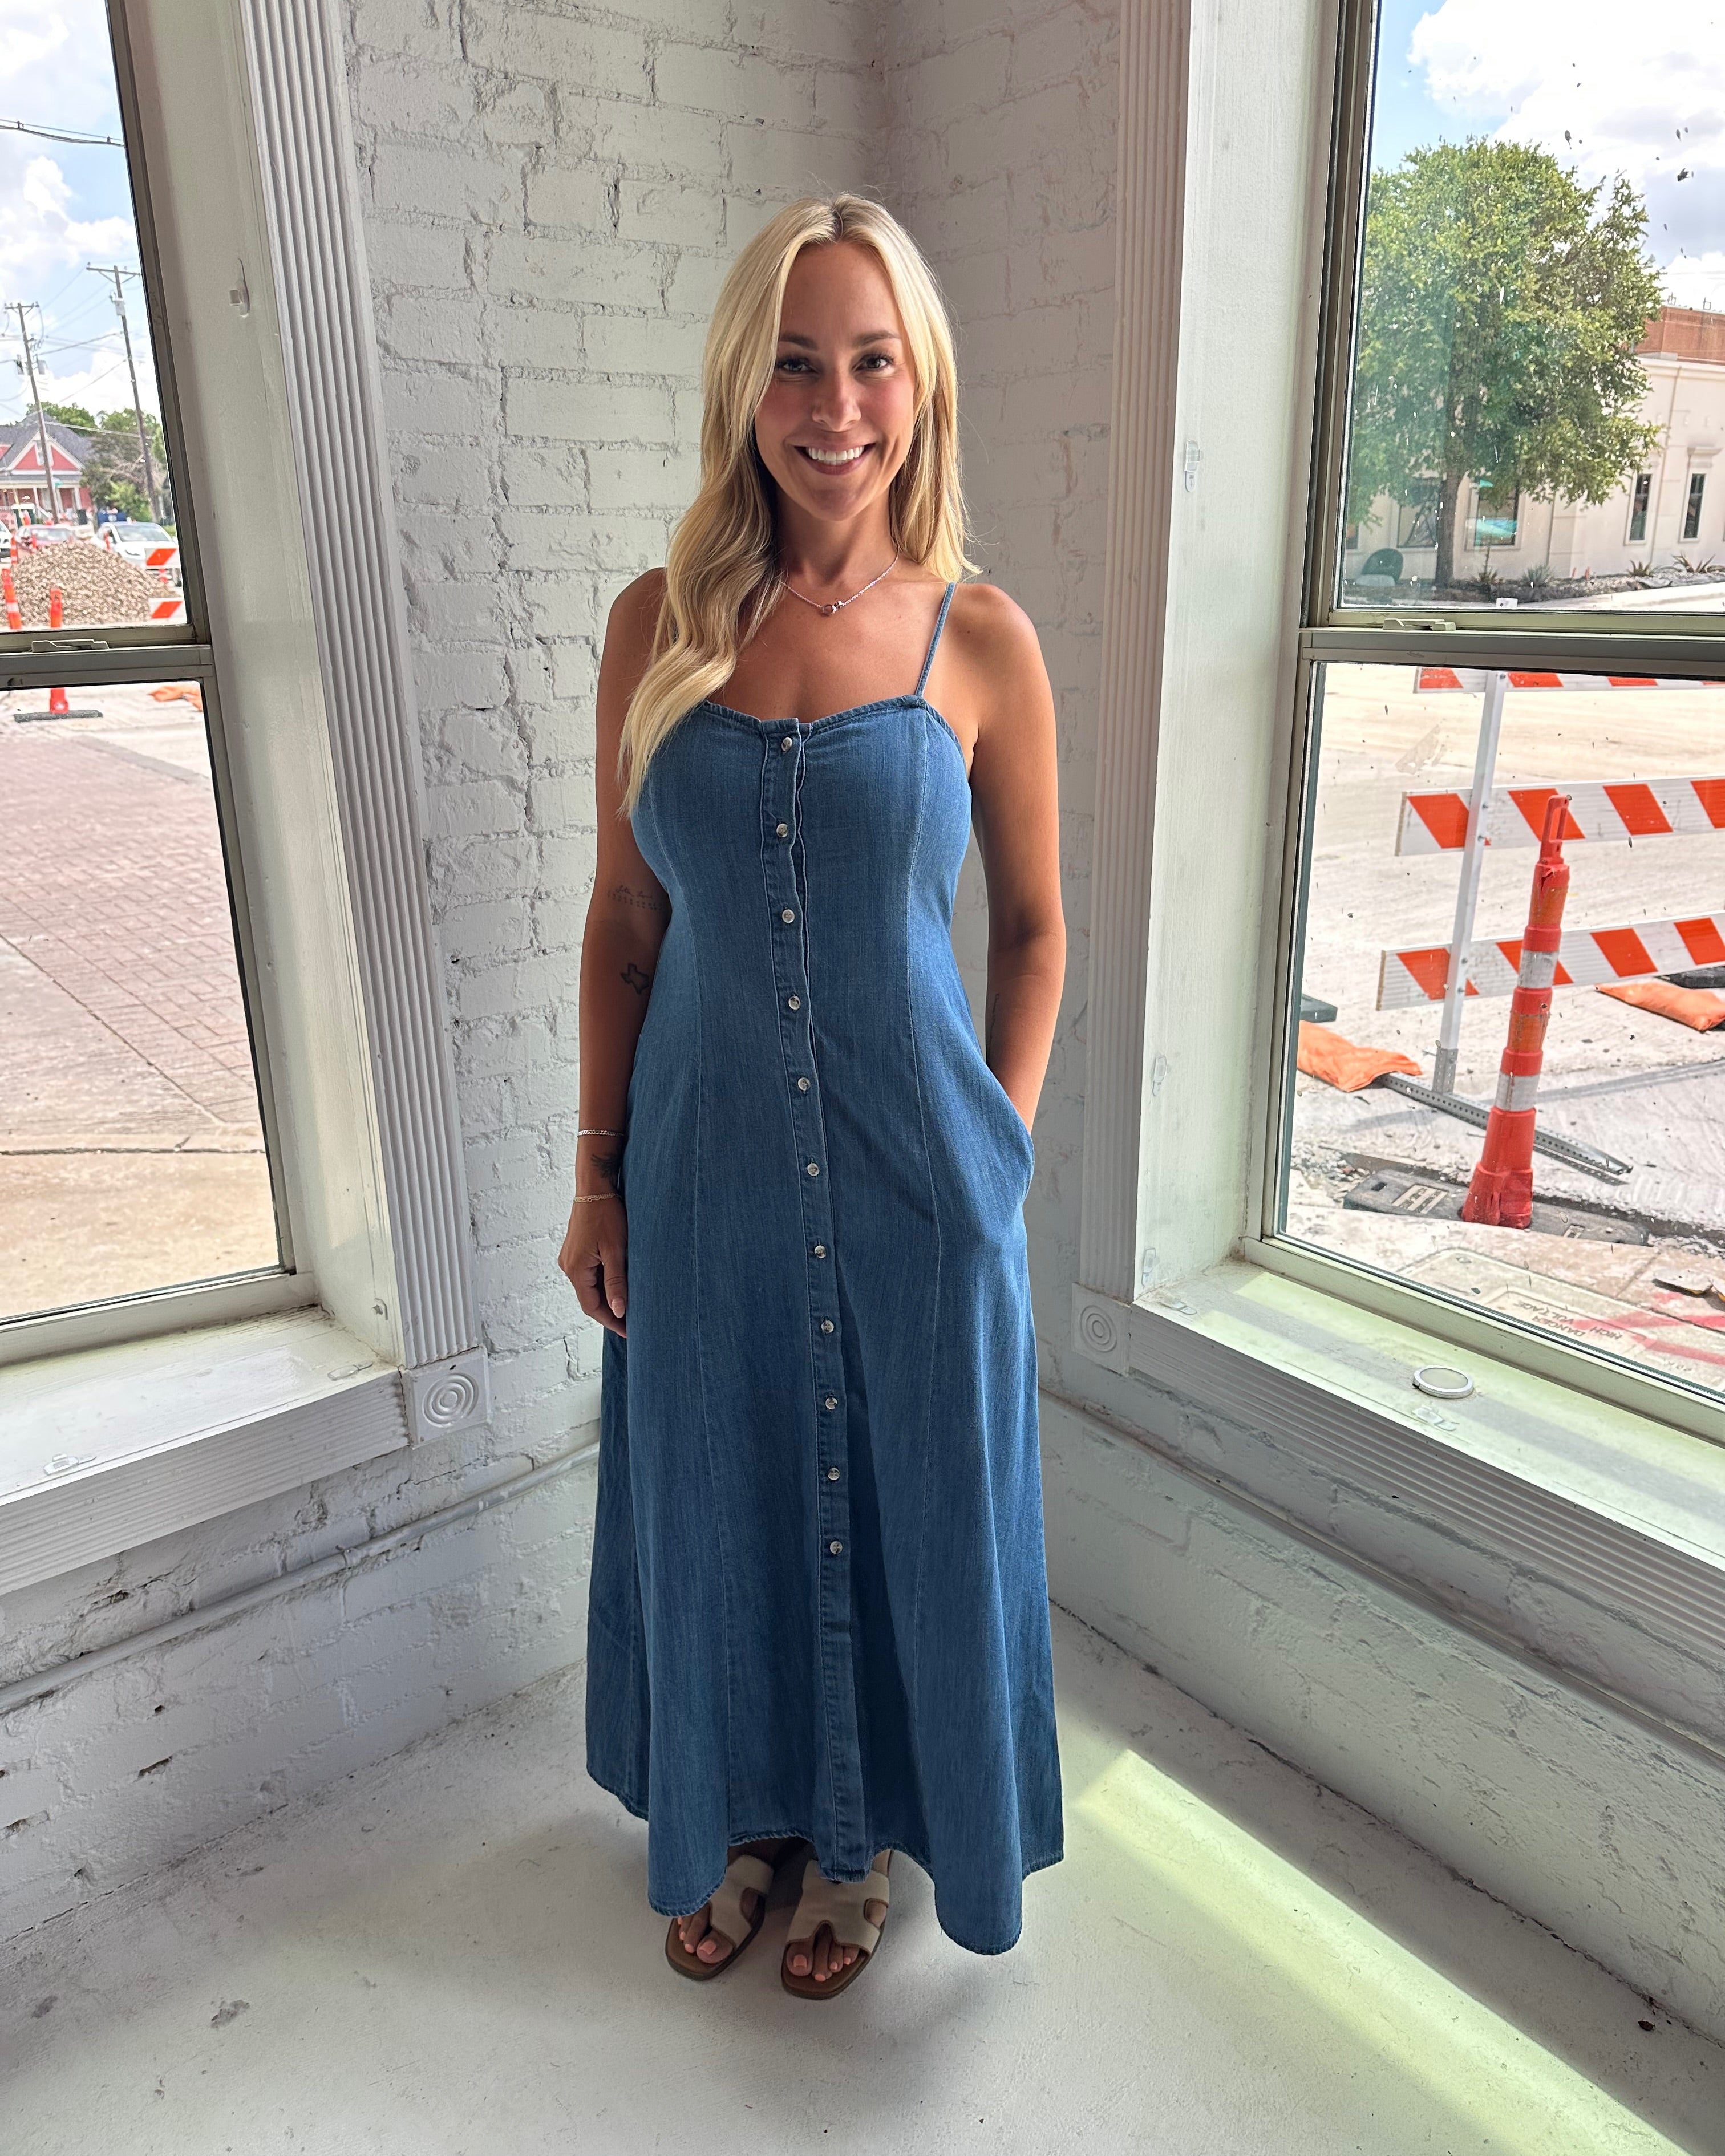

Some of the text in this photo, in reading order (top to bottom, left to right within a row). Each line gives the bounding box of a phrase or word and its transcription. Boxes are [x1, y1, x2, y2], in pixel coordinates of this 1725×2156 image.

[1514, 1301, 1622, 1340] HIGH VOLTAGE
[1532, 1315, 1586, 1337] DANGER
